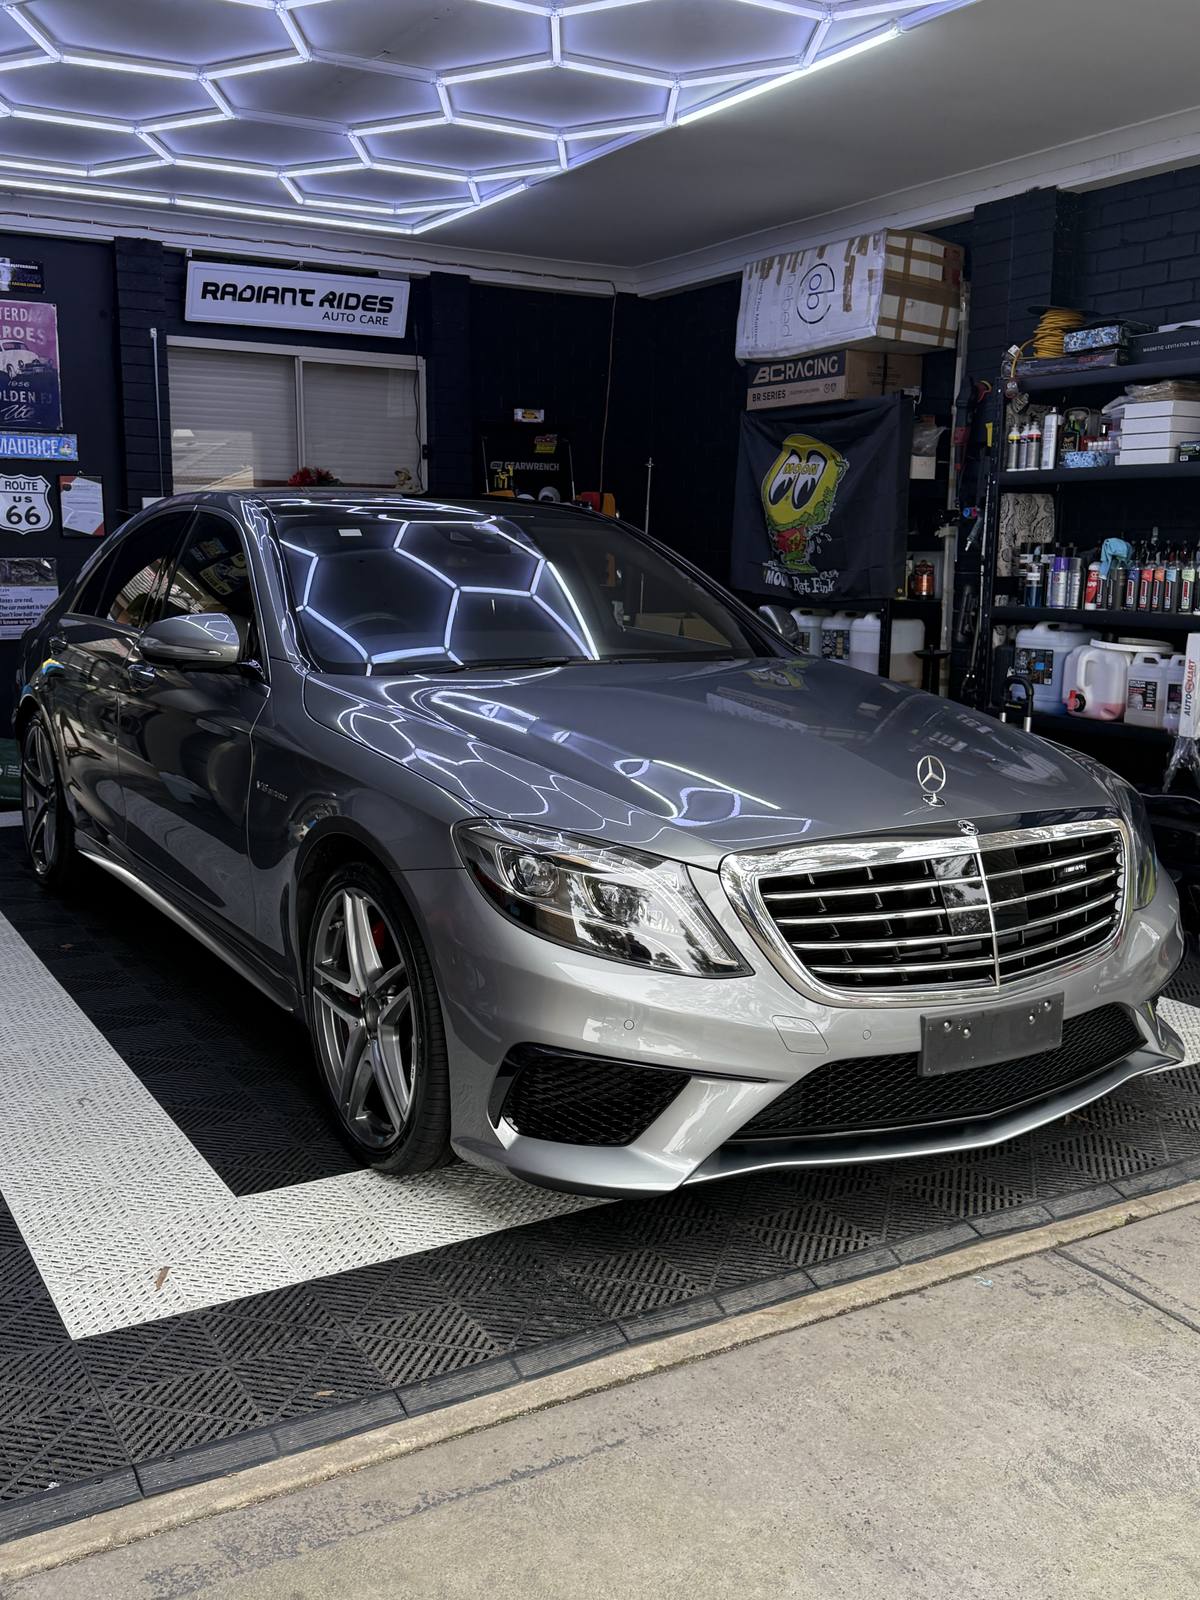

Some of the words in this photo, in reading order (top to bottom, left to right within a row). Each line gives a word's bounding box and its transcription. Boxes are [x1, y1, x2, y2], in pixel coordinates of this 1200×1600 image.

[200, 281, 316, 307] RADIANT
[318, 290, 395, 314] RIDES
[322, 311, 356, 323] AUTO
[359, 313, 390, 326] CARE
[0, 389, 37, 403] LDEN
[752, 392, 761, 402] BR
[762, 389, 787, 401] SERIES
[4, 480, 38, 491] ROUTE
[6, 505, 41, 526] 66
[792, 576, 811, 595] Rat
[811, 576, 835, 594] Fink
